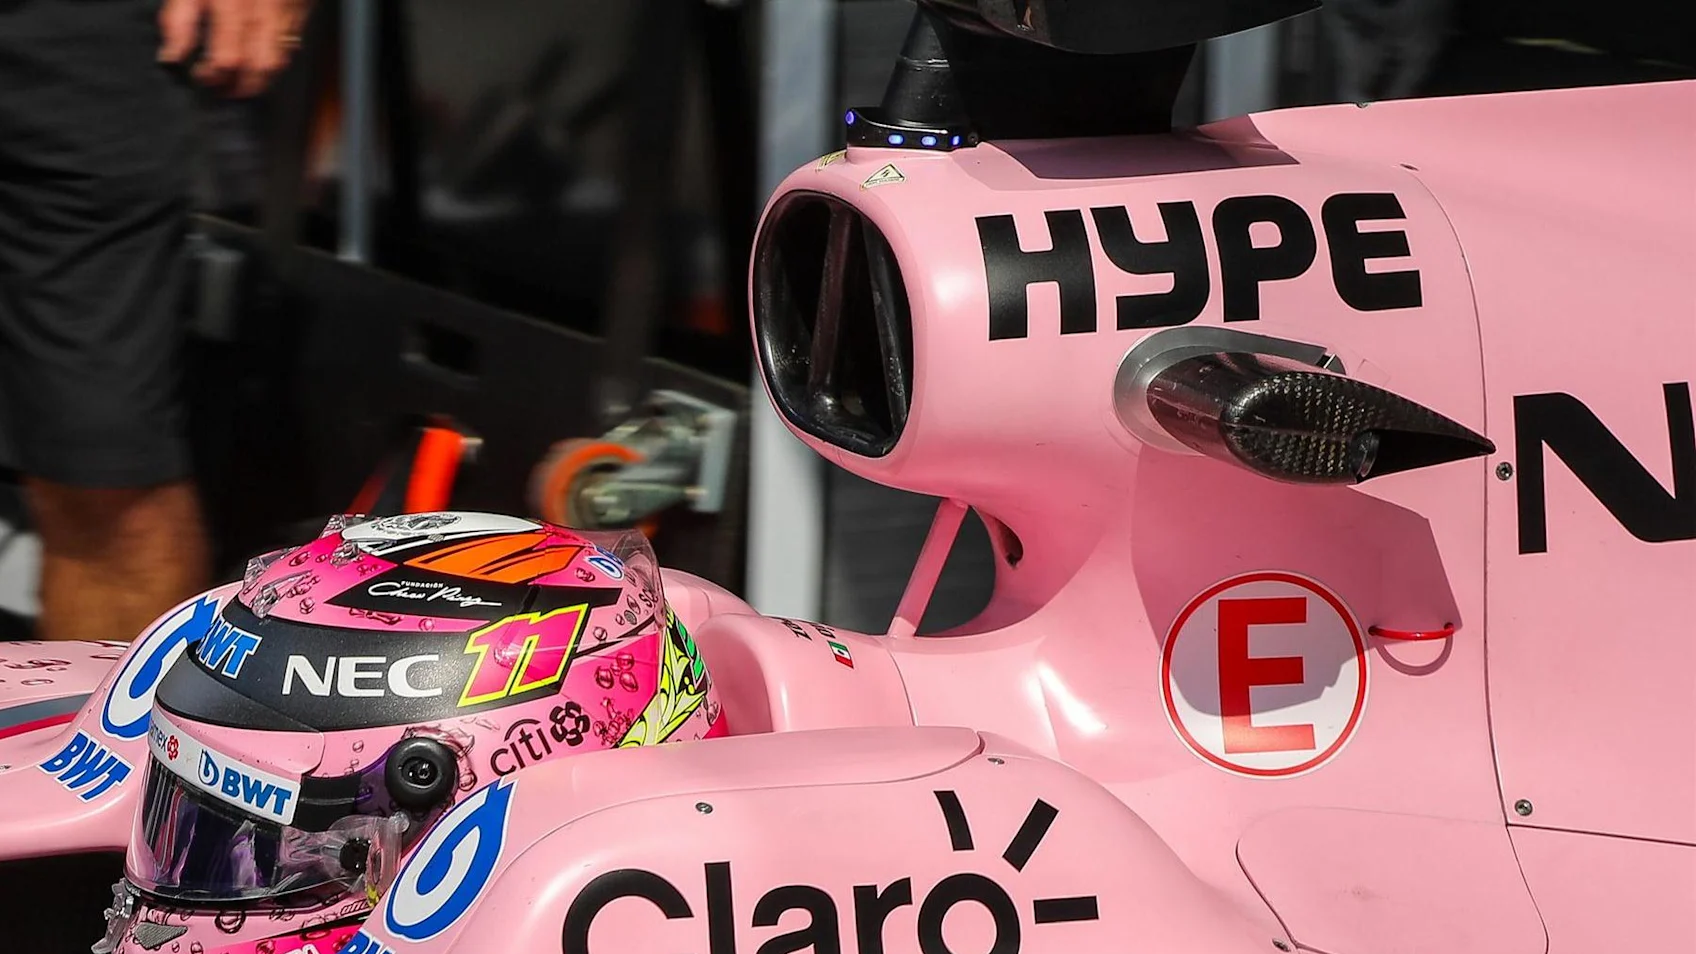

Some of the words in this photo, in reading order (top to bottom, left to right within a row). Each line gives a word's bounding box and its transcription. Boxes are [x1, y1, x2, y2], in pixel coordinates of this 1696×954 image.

[975, 193, 1422, 340] HYPE
[197, 617, 262, 679] WT
[281, 654, 443, 698] NEC
[457, 603, 589, 707] 11
[1217, 597, 1316, 755] E
[39, 731, 134, 802] BWT
[490, 718, 552, 777] citi
[221, 766, 292, 817] BWT
